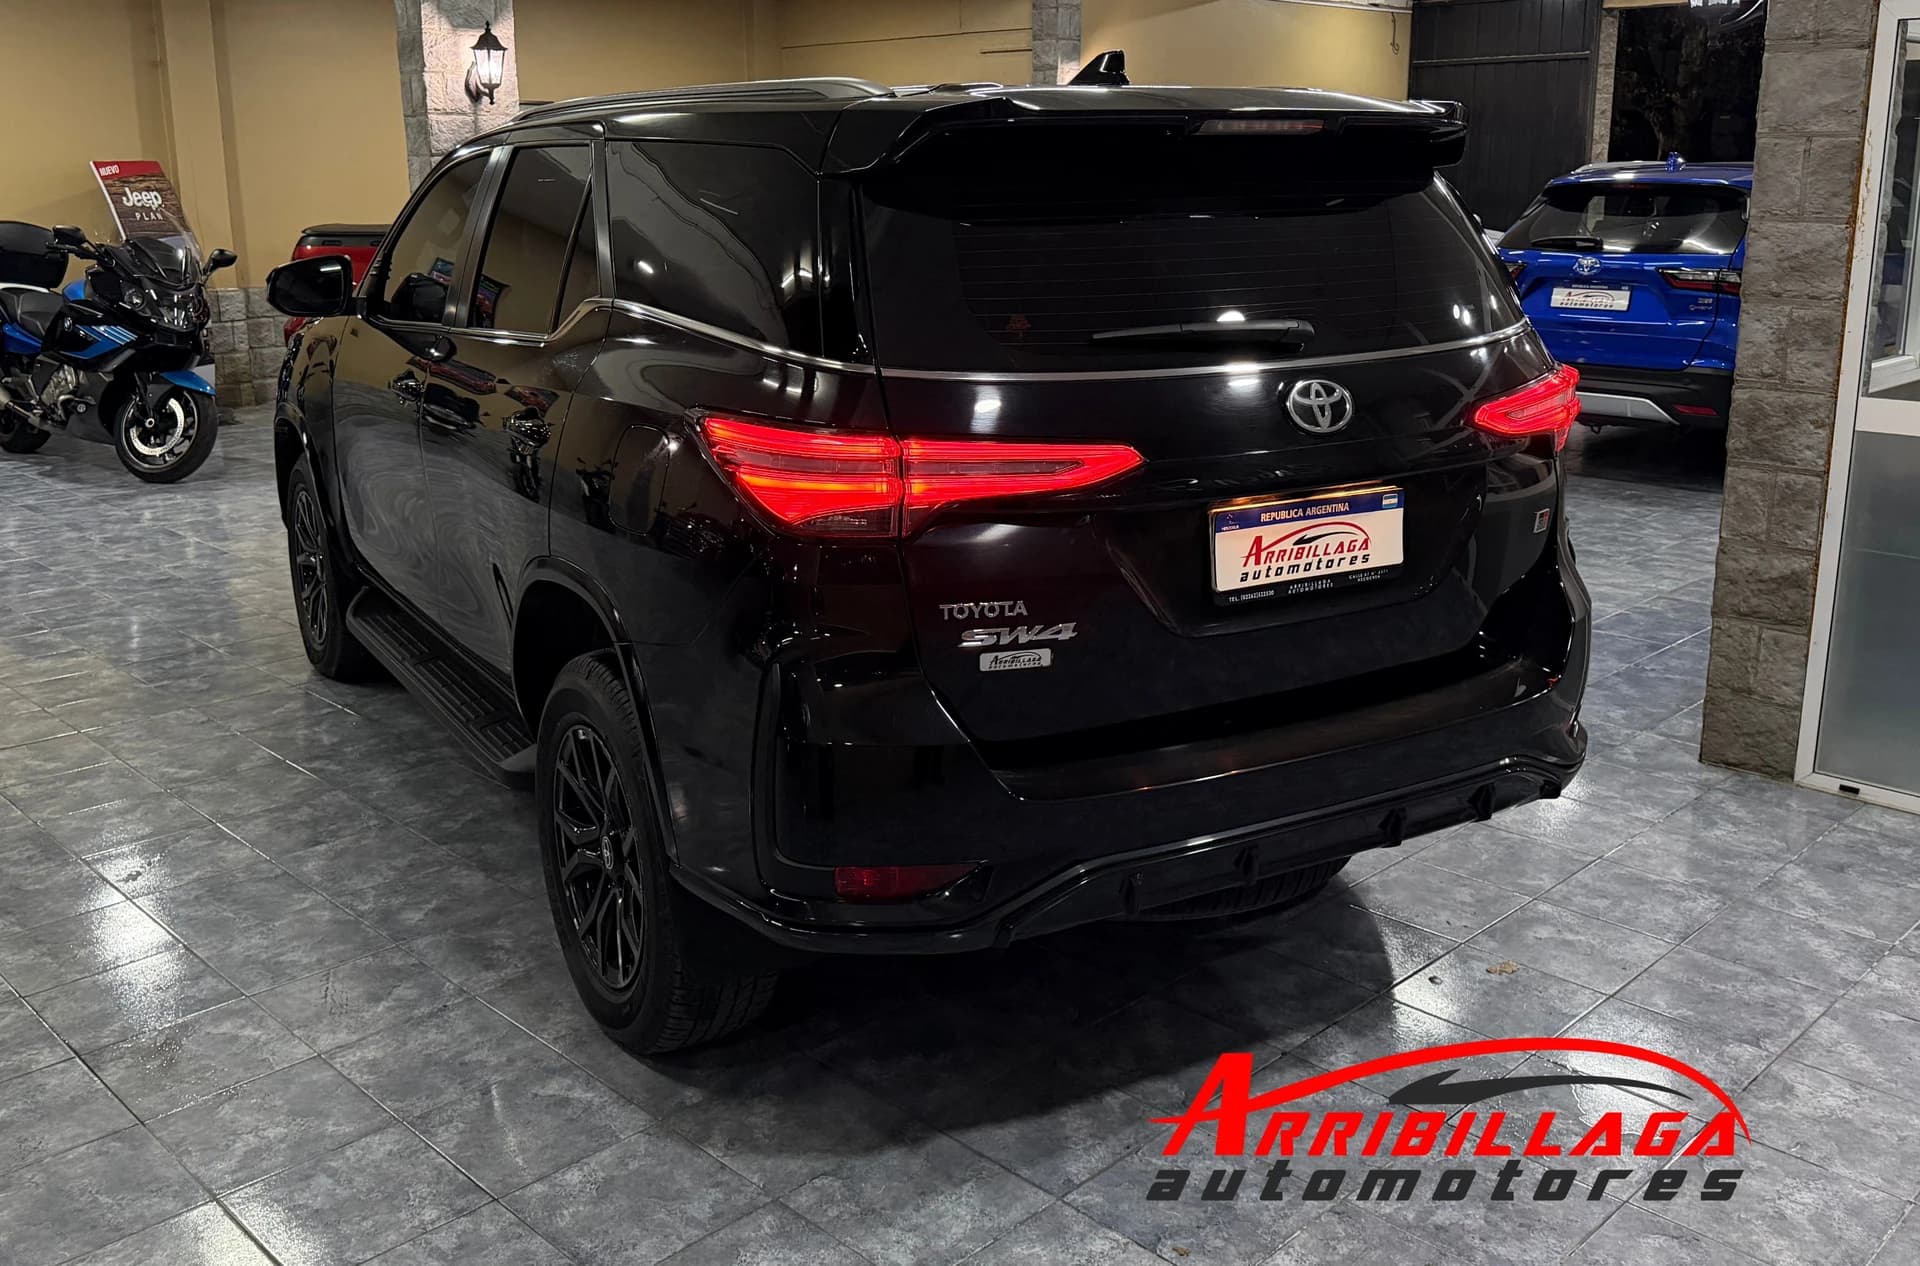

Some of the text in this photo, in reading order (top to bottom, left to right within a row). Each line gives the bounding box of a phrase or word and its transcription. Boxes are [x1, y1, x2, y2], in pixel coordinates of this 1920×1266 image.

[99, 165, 119, 176] NUEVO
[122, 187, 162, 210] Jeep
[135, 212, 163, 221] PLAN
[1261, 502, 1349, 522] REPUBLICA ARGENTINA
[1241, 535, 1370, 567] ARRIBILLAGA
[1240, 553, 1371, 582] automotores
[939, 600, 1028, 620] TOYOTA
[957, 622, 1078, 648] SW4
